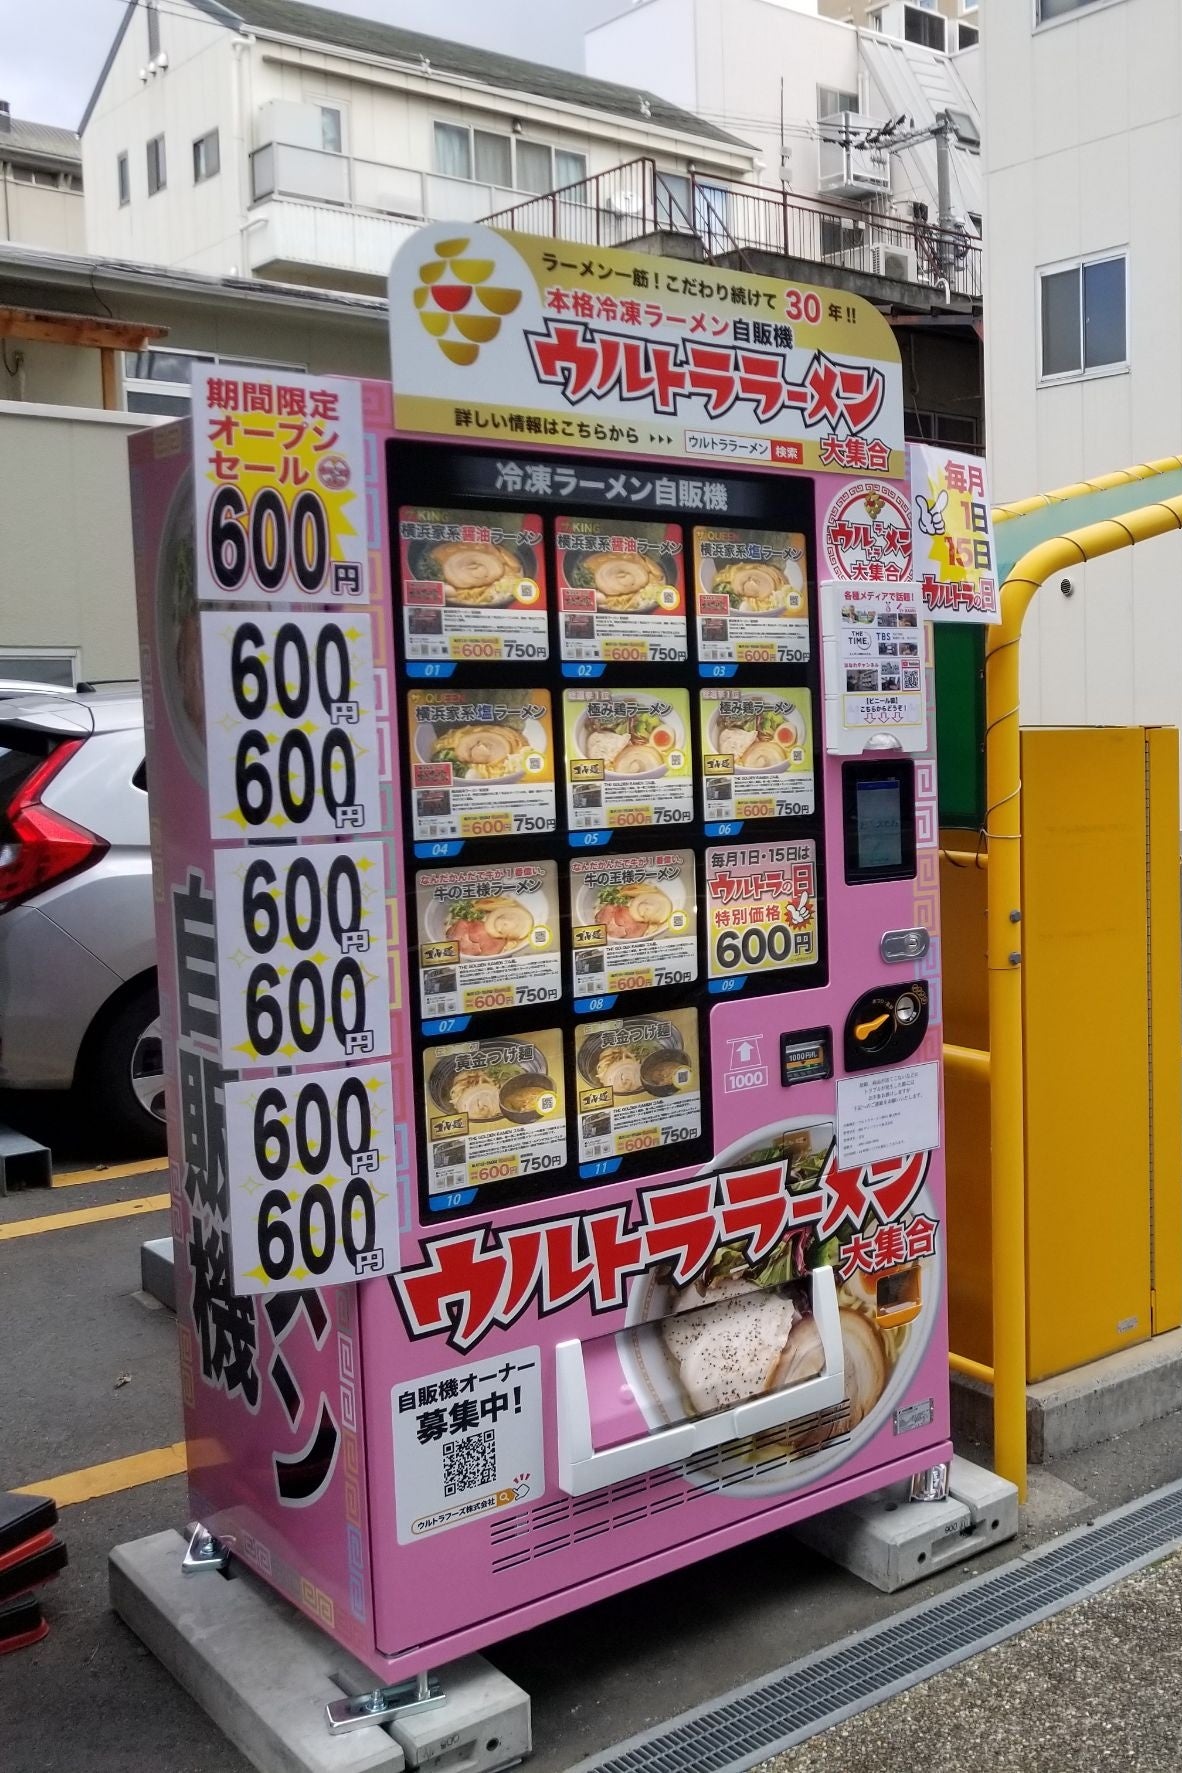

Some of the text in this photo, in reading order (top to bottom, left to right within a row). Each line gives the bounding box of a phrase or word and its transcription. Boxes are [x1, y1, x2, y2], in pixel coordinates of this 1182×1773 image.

[547, 287, 794, 350] 本格冷凍ラーメン自販機
[523, 318, 885, 434] ウルトララーメン
[206, 377, 340, 421] 期間限定
[208, 415, 340, 452] オープン
[454, 407, 641, 445] 詳しい情報はこちらから
[688, 435, 799, 460] ウルトララーメン 検索
[819, 433, 892, 472] 大集合
[208, 451, 310, 486] セール
[944, 459, 985, 498] 毎月
[495, 461, 729, 512] 冷凍ラーメン自販機
[206, 482, 363, 596] 600円
[851, 561, 902, 583] 大集合
[876, 632, 891, 641] TBS
[231, 621, 360, 725] 600円
[424, 664, 441, 676] 01
[578, 665, 592, 677] 02
[713, 666, 726, 677] 03
[587, 702, 673, 718] 極み鶏ラーメン
[719, 701, 795, 716] 極み鶏ラーメン
[235, 728, 365, 829] 600円
[584, 833, 599, 845] 05
[718, 824, 732, 835] 06
[432, 843, 449, 856] 04
[434, 878, 543, 903] 牛の王様ラーメン
[584, 866, 681, 888] 牛の王様ラーメン
[708, 862, 815, 904] ウルトラの日
[243, 855, 370, 954] 600円
[715, 904, 781, 928] 特別価格
[716, 924, 814, 969] 600円
[722, 979, 735, 991] 09
[246, 956, 375, 1056] 600円
[589, 998, 604, 1010] 08
[439, 1019, 455, 1032] 07
[601, 1021, 672, 1048] 黄金つけ麺
[455, 1044, 534, 1072] 黄金つけ麺
[729, 1070, 763, 1090] 1000
[254, 1077, 380, 1181] 600円
[595, 1162, 608, 1175] 11
[447, 1193, 461, 1207] 10
[257, 1177, 385, 1280] 600円
[392, 1152, 930, 1353] ウルトララーメン
[838, 1214, 938, 1280] 大集合
[398, 1362, 536, 1414] 自販機オーナー
[417, 1498, 496, 1531] ウルトラフーズ株式会社
